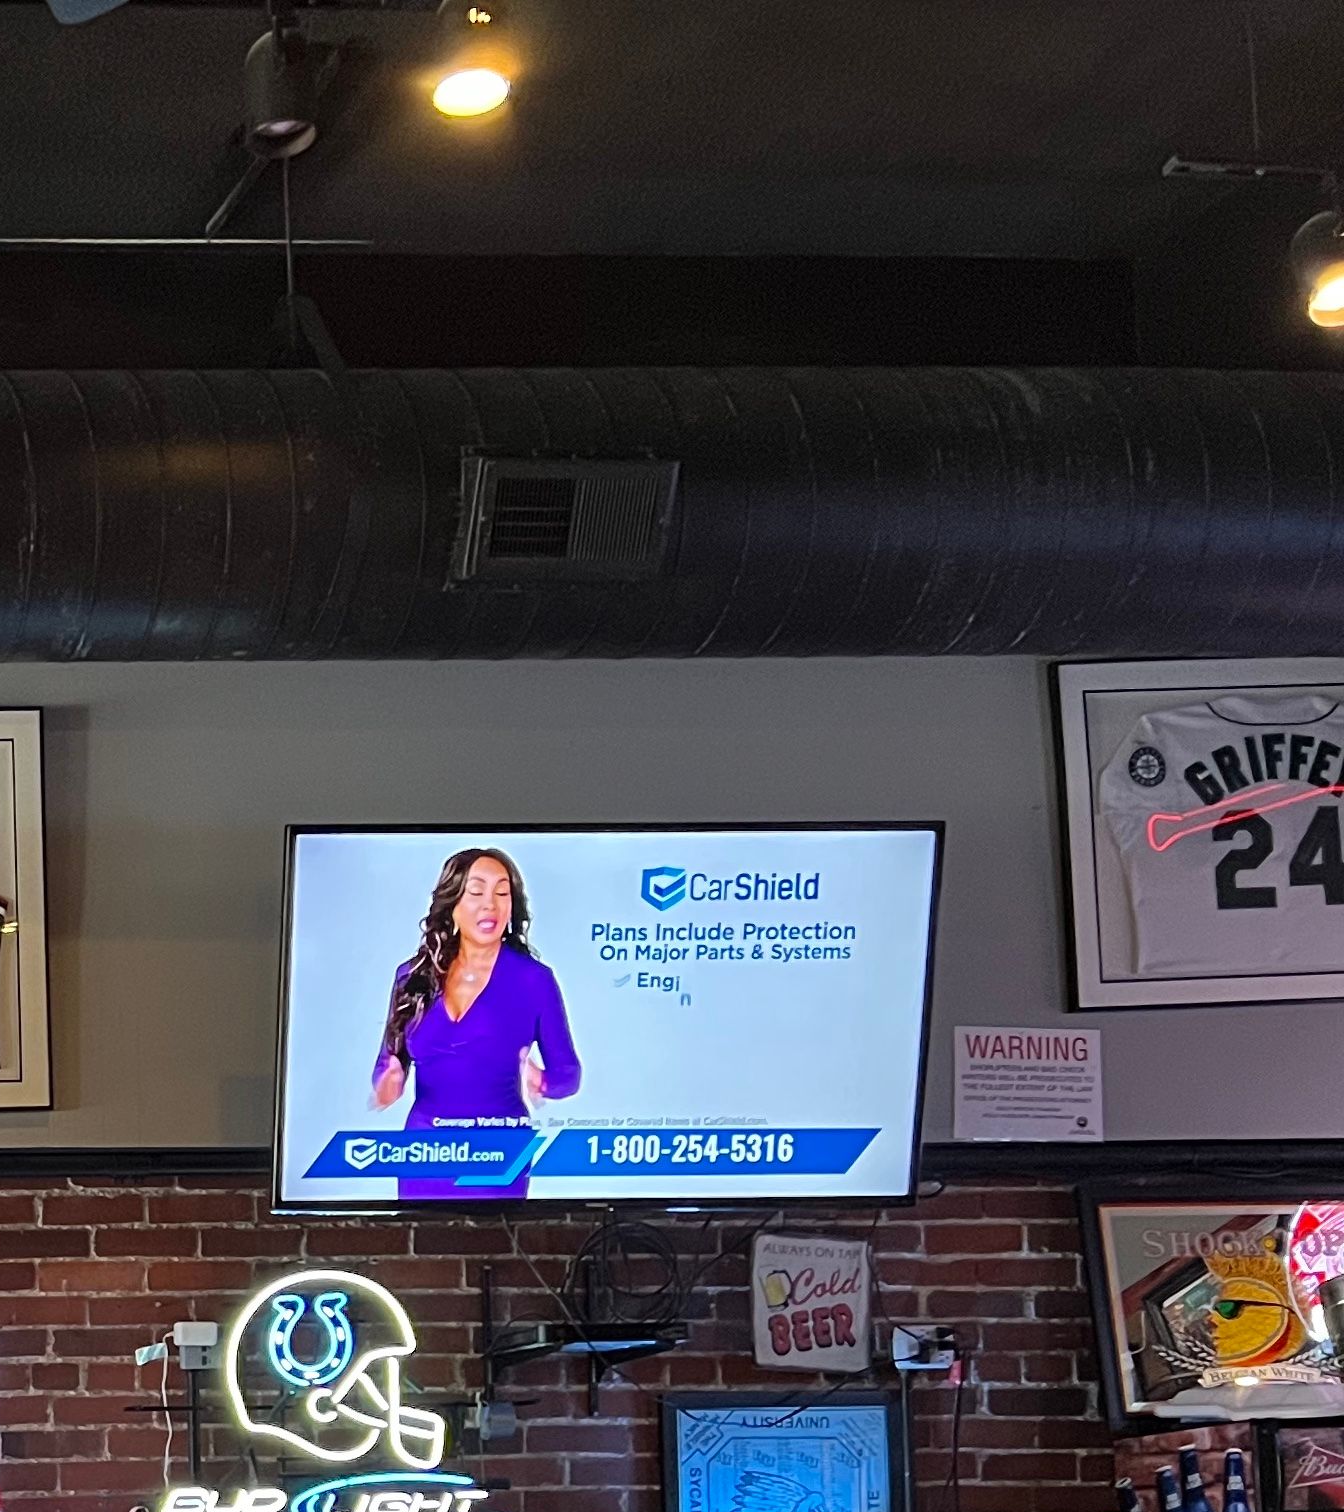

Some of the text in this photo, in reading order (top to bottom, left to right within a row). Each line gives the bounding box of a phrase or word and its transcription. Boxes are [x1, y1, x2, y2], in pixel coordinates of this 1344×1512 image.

[1184, 733, 1344, 806] GRIFFE
[1213, 805, 1344, 910] 24
[689, 873, 820, 901] CarShield
[591, 922, 856, 941] Plans Include Protection
[600, 944, 851, 963] On Major Parts & Systems
[965, 1034, 1088, 1061] WARNING
[477, 1117, 505, 1127] Varies
[506, 1117, 517, 1128] by
[378, 1141, 504, 1163] CarShield.com
[587, 1133, 794, 1164] 1-800-254-5316
[763, 1243, 811, 1256] ALWAYS
[814, 1247, 834, 1258] ON
[1143, 1230, 1264, 1258] SHOCK
[792, 1267, 861, 1305] Cold
[768, 1303, 856, 1356] BEER
[1271, 1366, 1315, 1382] WHITE
[741, 1416, 830, 1429] UNIVERSITY
